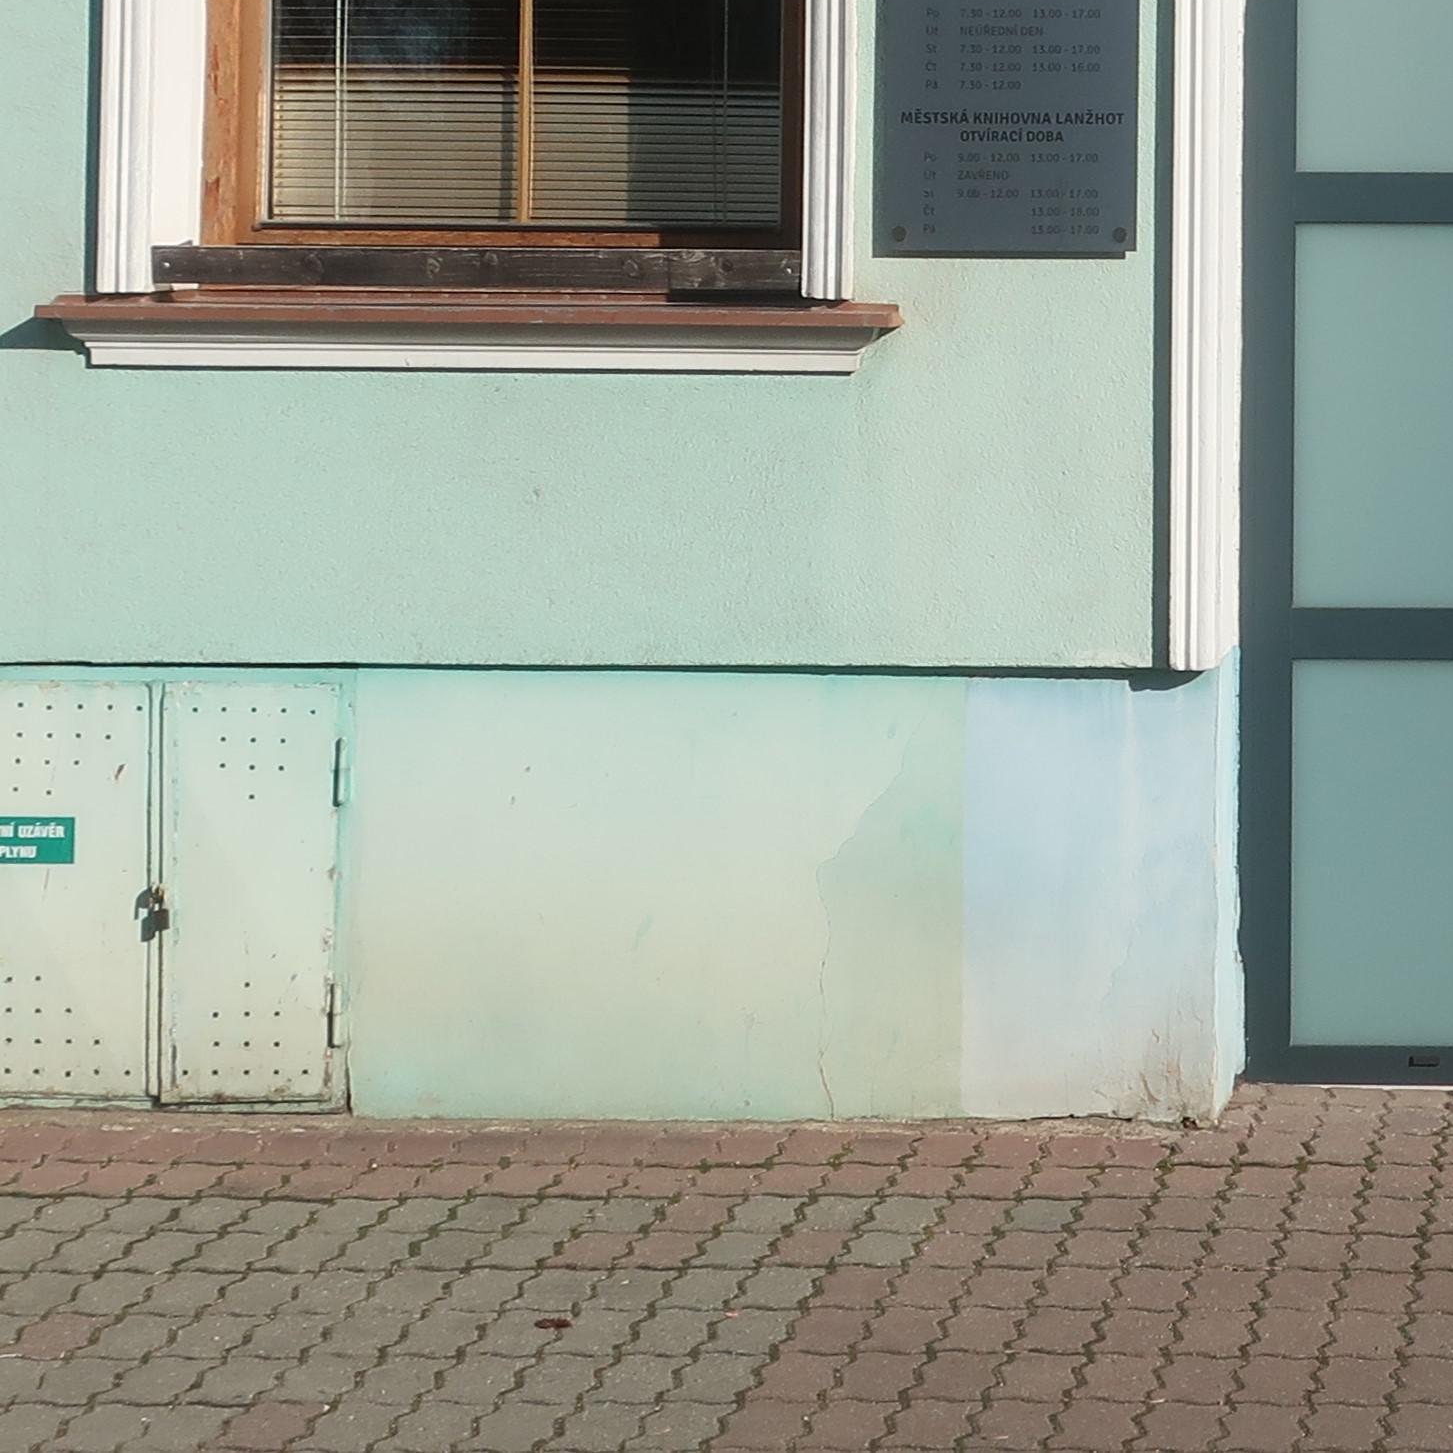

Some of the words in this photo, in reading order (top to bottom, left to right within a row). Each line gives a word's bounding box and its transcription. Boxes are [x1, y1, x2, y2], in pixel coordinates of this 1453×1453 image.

[959, 8, 983, 19] 7.30
[992, 8, 1023, 19] 12.00
[1072, 9, 1101, 20] 17.00
[959, 43, 983, 54] 7.30
[991, 43, 1022, 54] 12.00
[991, 61, 1022, 72] 12.00
[959, 79, 983, 90] 7.30
[991, 79, 1022, 90] 12.00
[900, 107, 970, 124] MĚSTSKÁ
[973, 112, 1052, 125] KNIHOVNA
[1055, 108, 1126, 125] LANŽHOT
[960, 127, 1023, 142] OTVÍRACÍ
[1026, 130, 1065, 142] DOBA
[990, 152, 1020, 164] 12.00
[1070, 153, 1099, 164] 17.00
